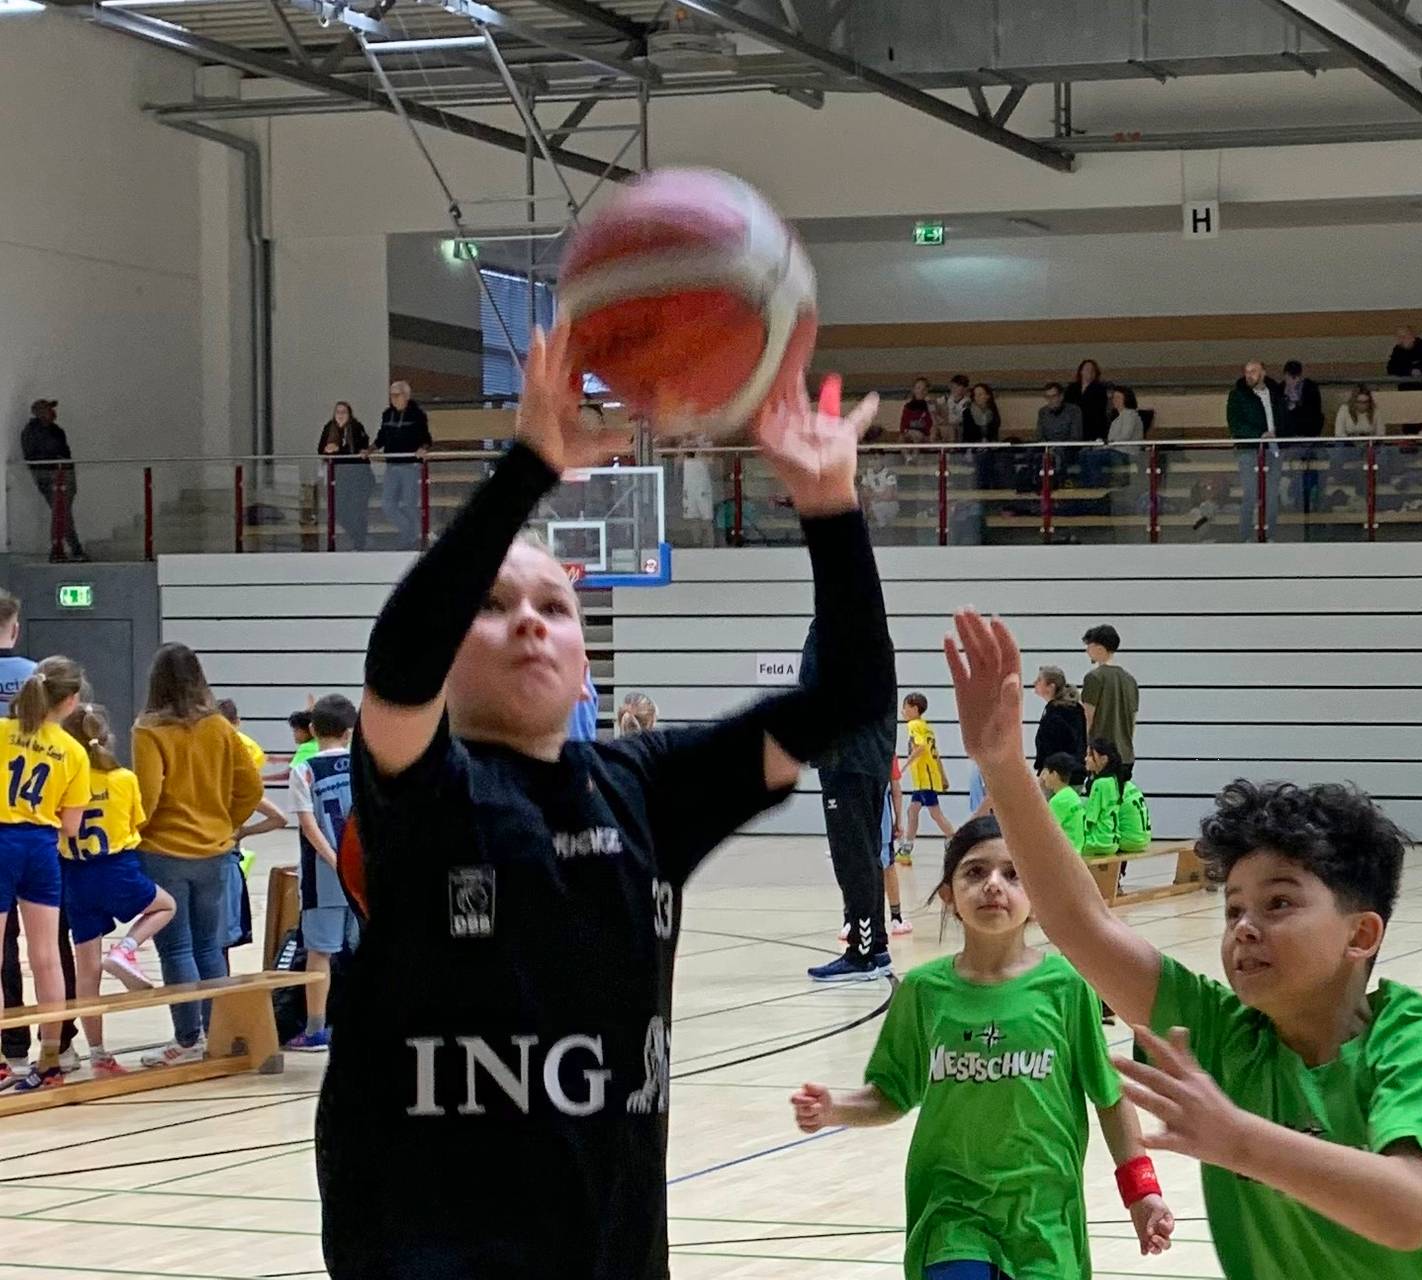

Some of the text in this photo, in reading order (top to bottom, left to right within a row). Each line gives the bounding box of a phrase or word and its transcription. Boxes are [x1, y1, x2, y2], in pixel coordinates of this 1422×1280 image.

[1192, 207, 1211, 233] H
[759, 663, 794, 675] Feld A
[8, 754, 51, 812] 14
[405, 1033, 612, 1117] ING
[930, 1044, 1056, 1082] WESTSCHULE
